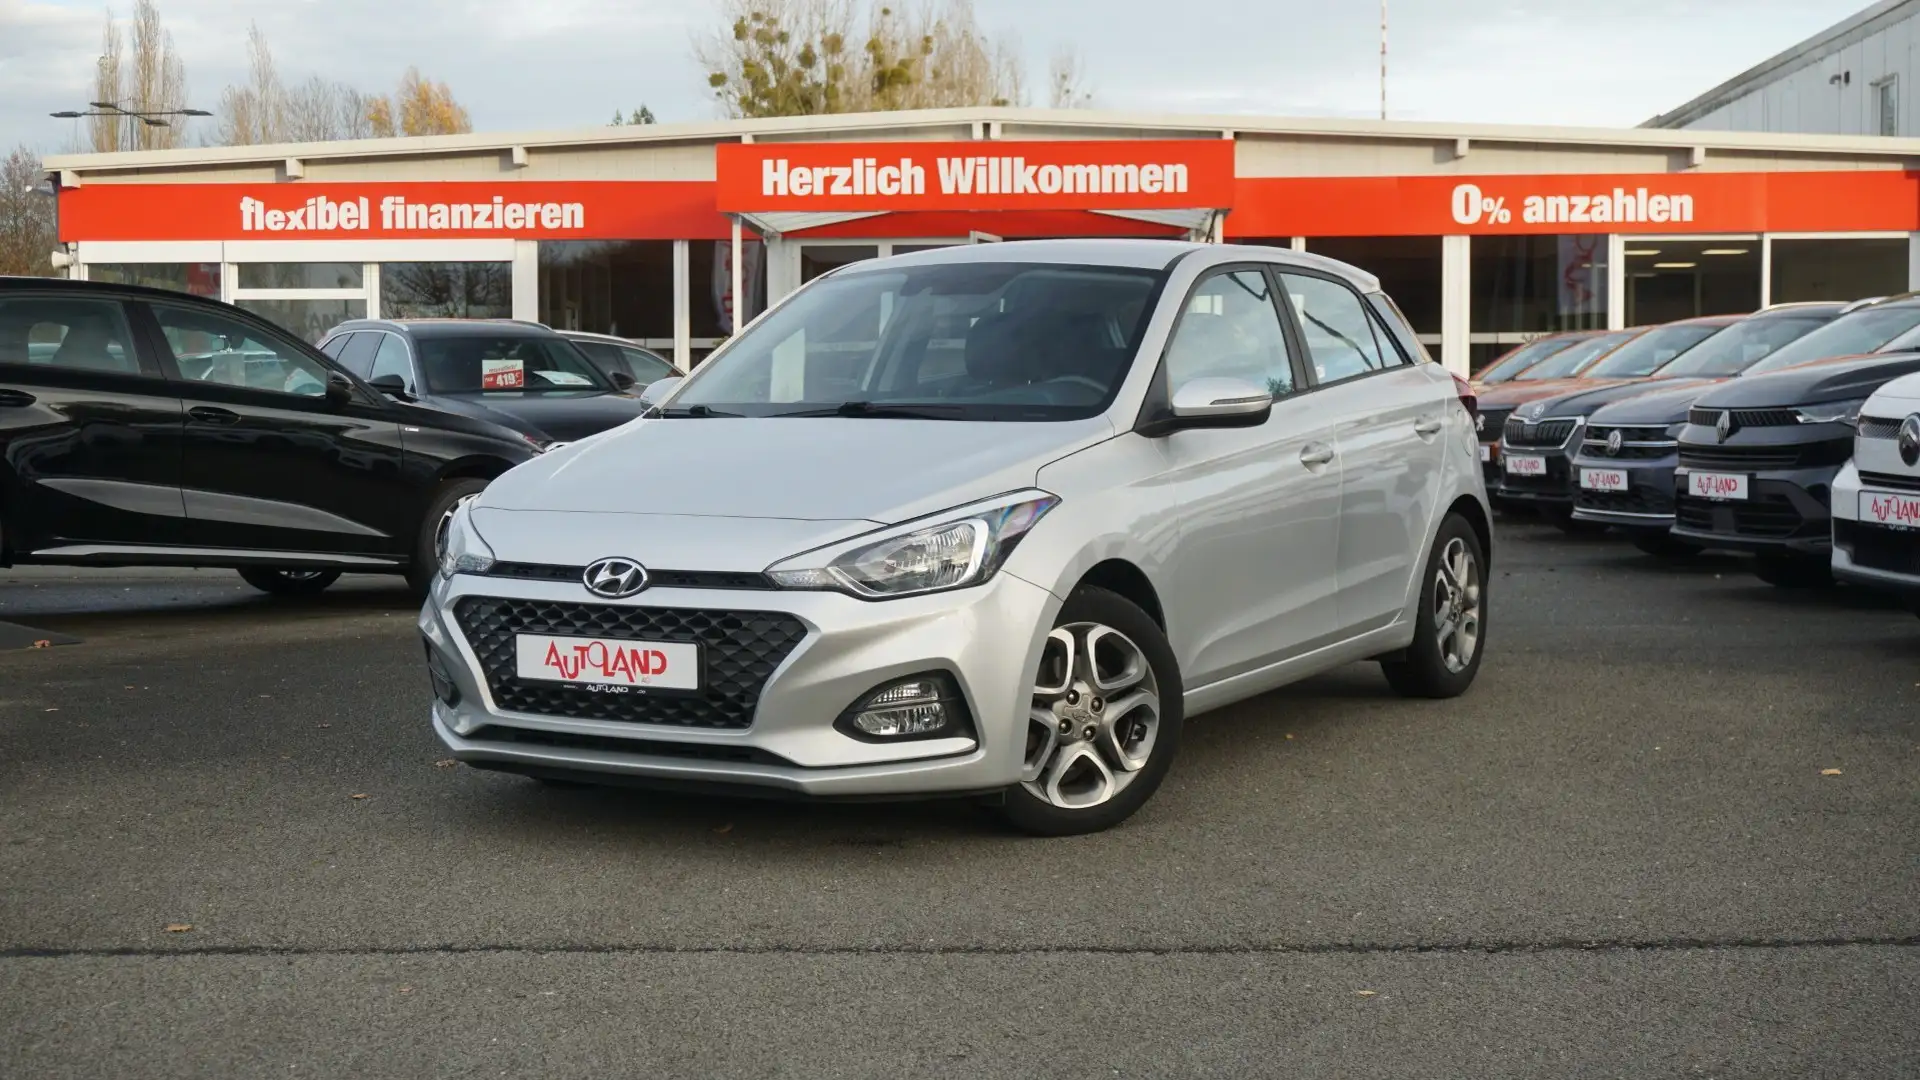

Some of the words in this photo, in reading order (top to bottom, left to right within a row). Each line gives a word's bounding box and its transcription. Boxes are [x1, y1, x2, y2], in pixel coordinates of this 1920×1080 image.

[762, 157, 925, 196] Herzlich
[936, 156, 1188, 194] Willkommen
[240, 195, 370, 231] flexibel
[380, 195, 585, 230] finanzieren
[1451, 183, 1511, 225] 0%
[1523, 187, 1694, 223] anzahlen
[1696, 473, 1738, 496] AUTOLAND
[1871, 495, 1920, 525] AUTOLAN
[545, 640, 667, 682] AUTOLAND
[585, 684, 628, 694] AUTOLAND
